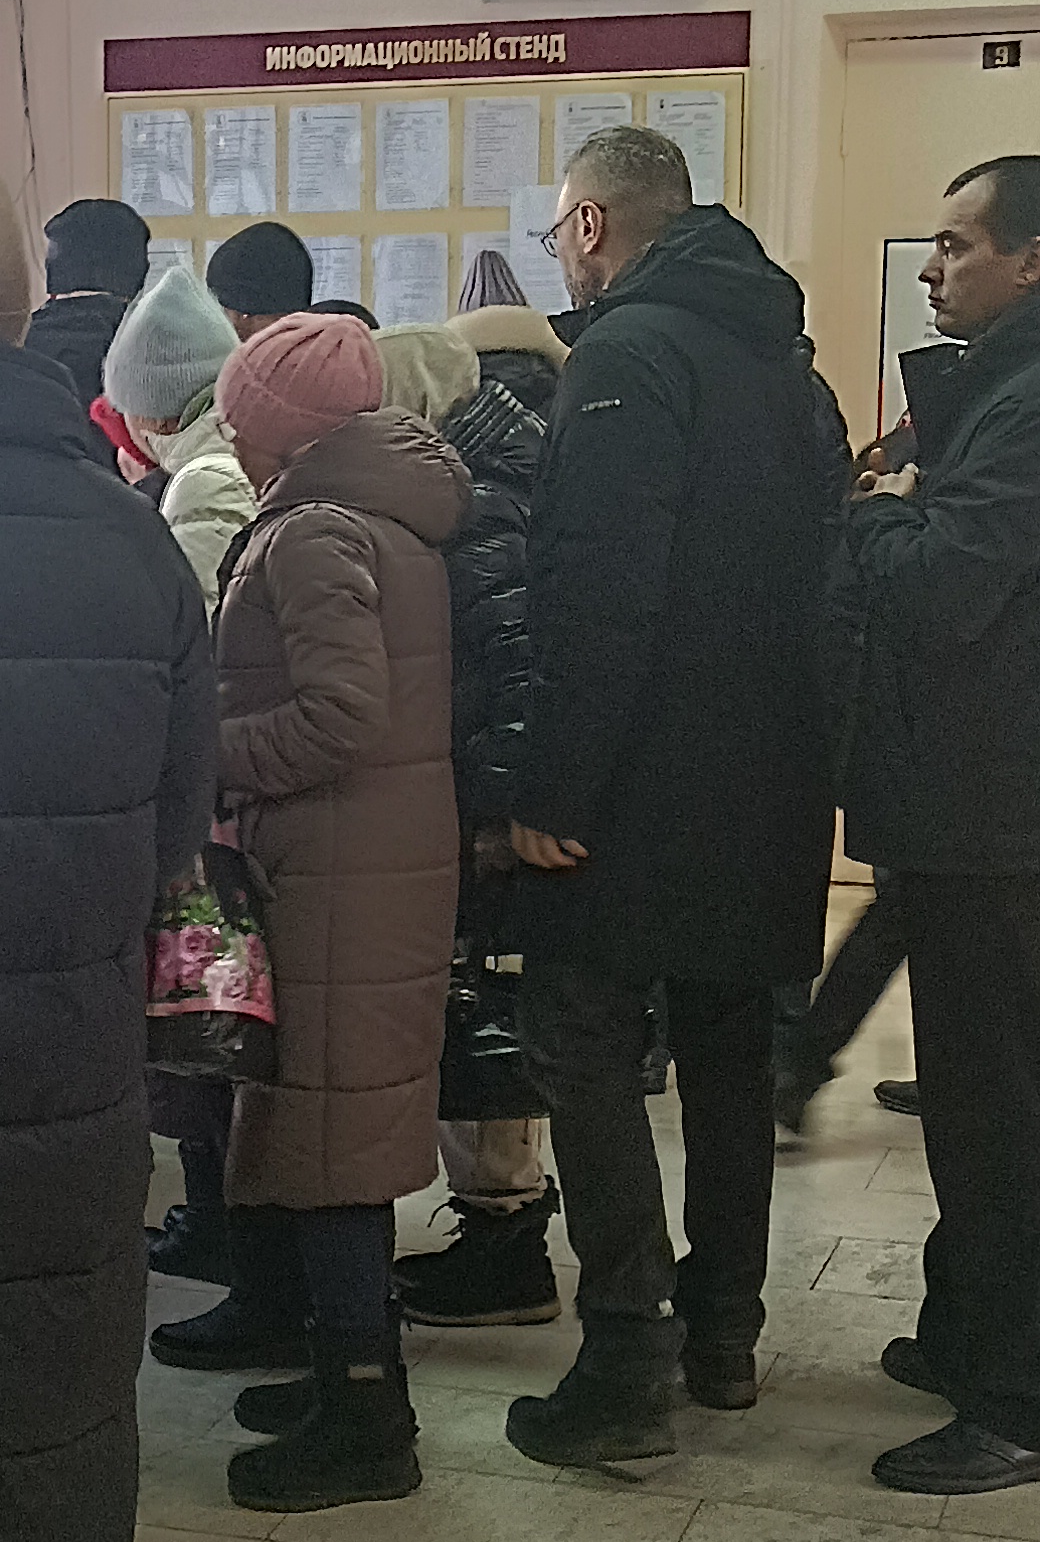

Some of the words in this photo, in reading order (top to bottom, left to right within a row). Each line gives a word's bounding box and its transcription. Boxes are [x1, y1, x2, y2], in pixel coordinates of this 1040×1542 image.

[265, 31, 491, 71] ИНФОРМАЦИОННЫЙ
[493, 33, 566, 64] СТЕНД
[994, 45, 1009, 65] 9
